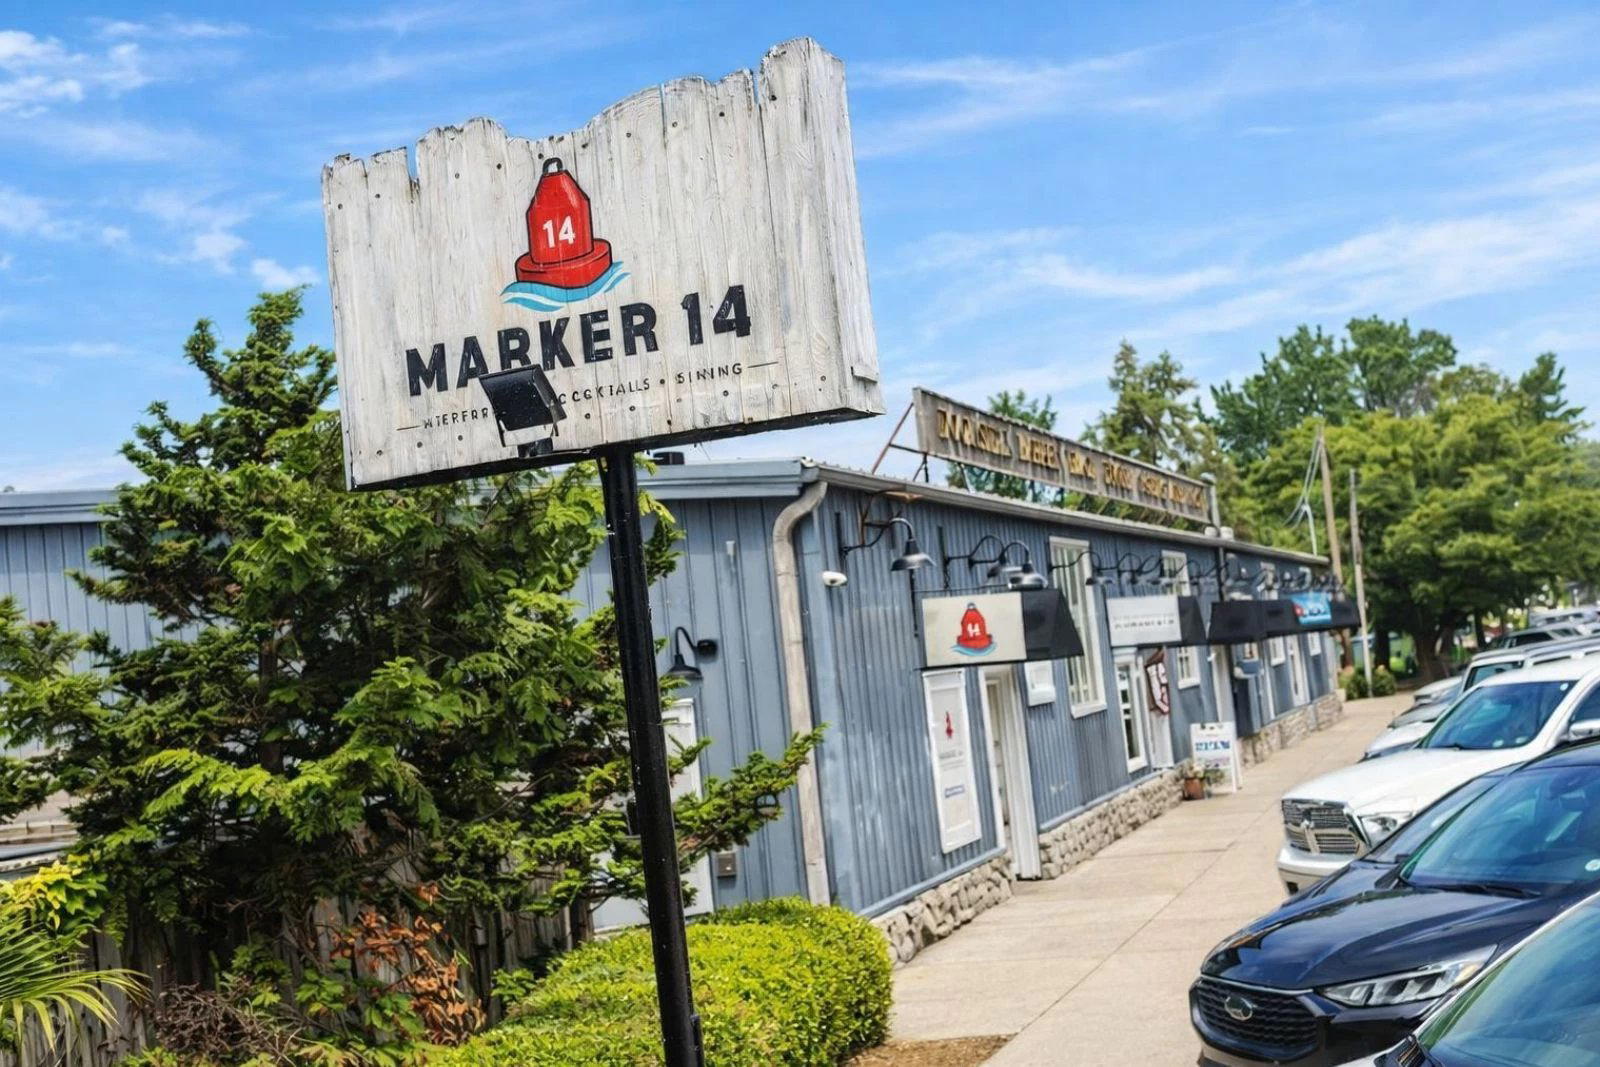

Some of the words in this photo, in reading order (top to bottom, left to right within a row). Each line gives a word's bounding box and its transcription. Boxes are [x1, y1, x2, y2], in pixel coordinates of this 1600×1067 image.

[542, 215, 576, 249] 14
[405, 302, 660, 397] MARKER
[680, 284, 752, 347] 14
